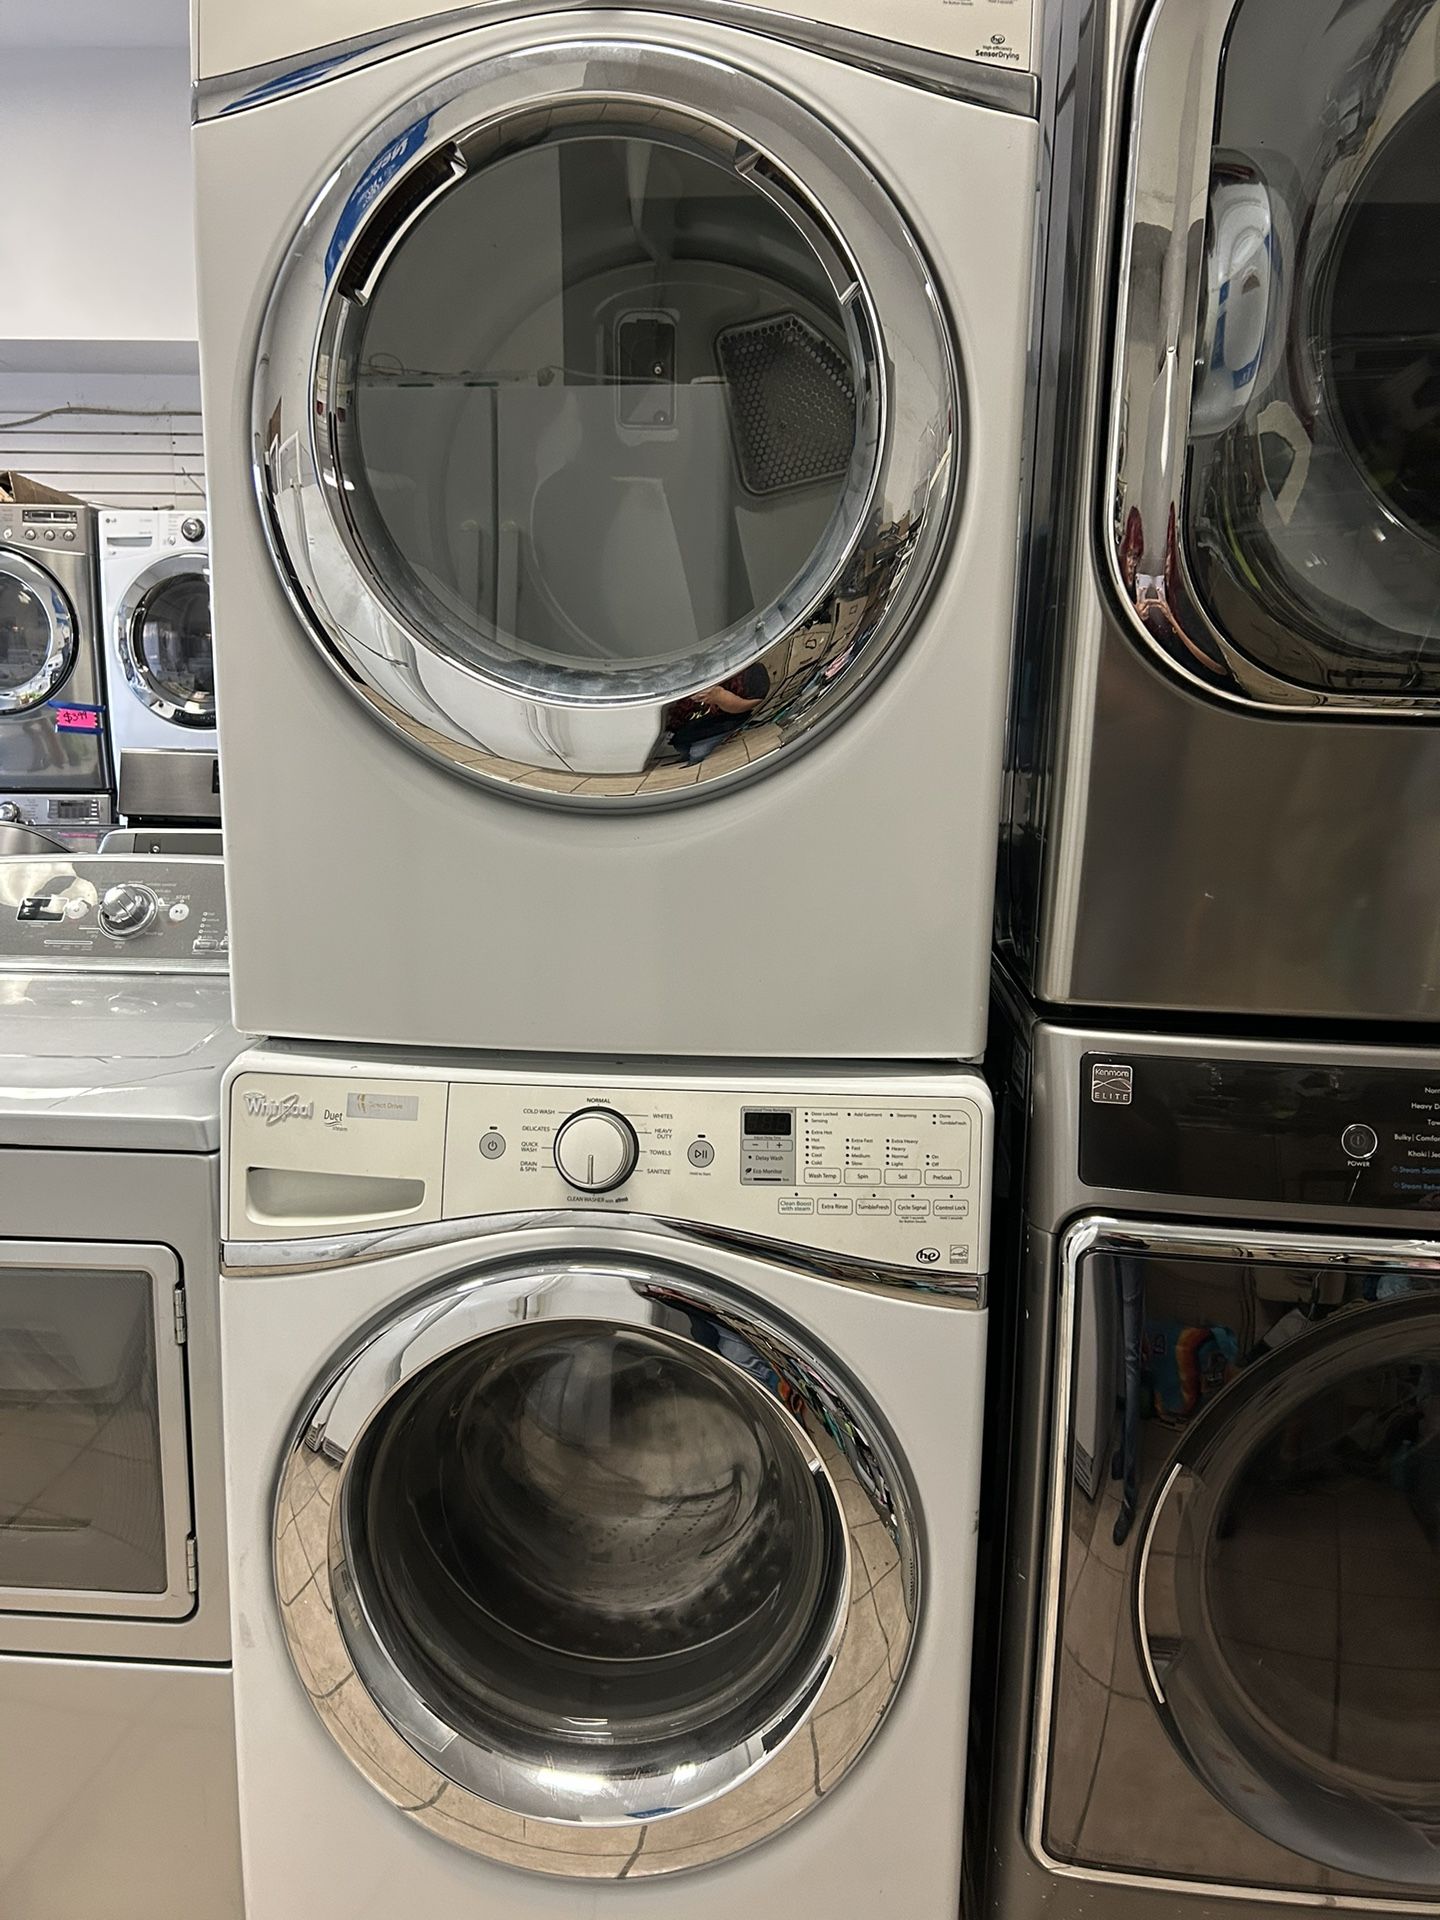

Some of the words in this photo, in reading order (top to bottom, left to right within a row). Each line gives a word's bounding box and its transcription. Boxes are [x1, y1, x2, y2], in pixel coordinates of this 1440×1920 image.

[975, 50, 1020, 61] SensorDrying
[1095, 1068, 1130, 1077] Kenmore
[1094, 1091, 1129, 1101] ELITE
[243, 1093, 314, 1126] Whirlpool
[1411, 1102, 1432, 1111] Heavy
[323, 1109, 343, 1121] Duet
[917, 1248, 940, 1263] he
